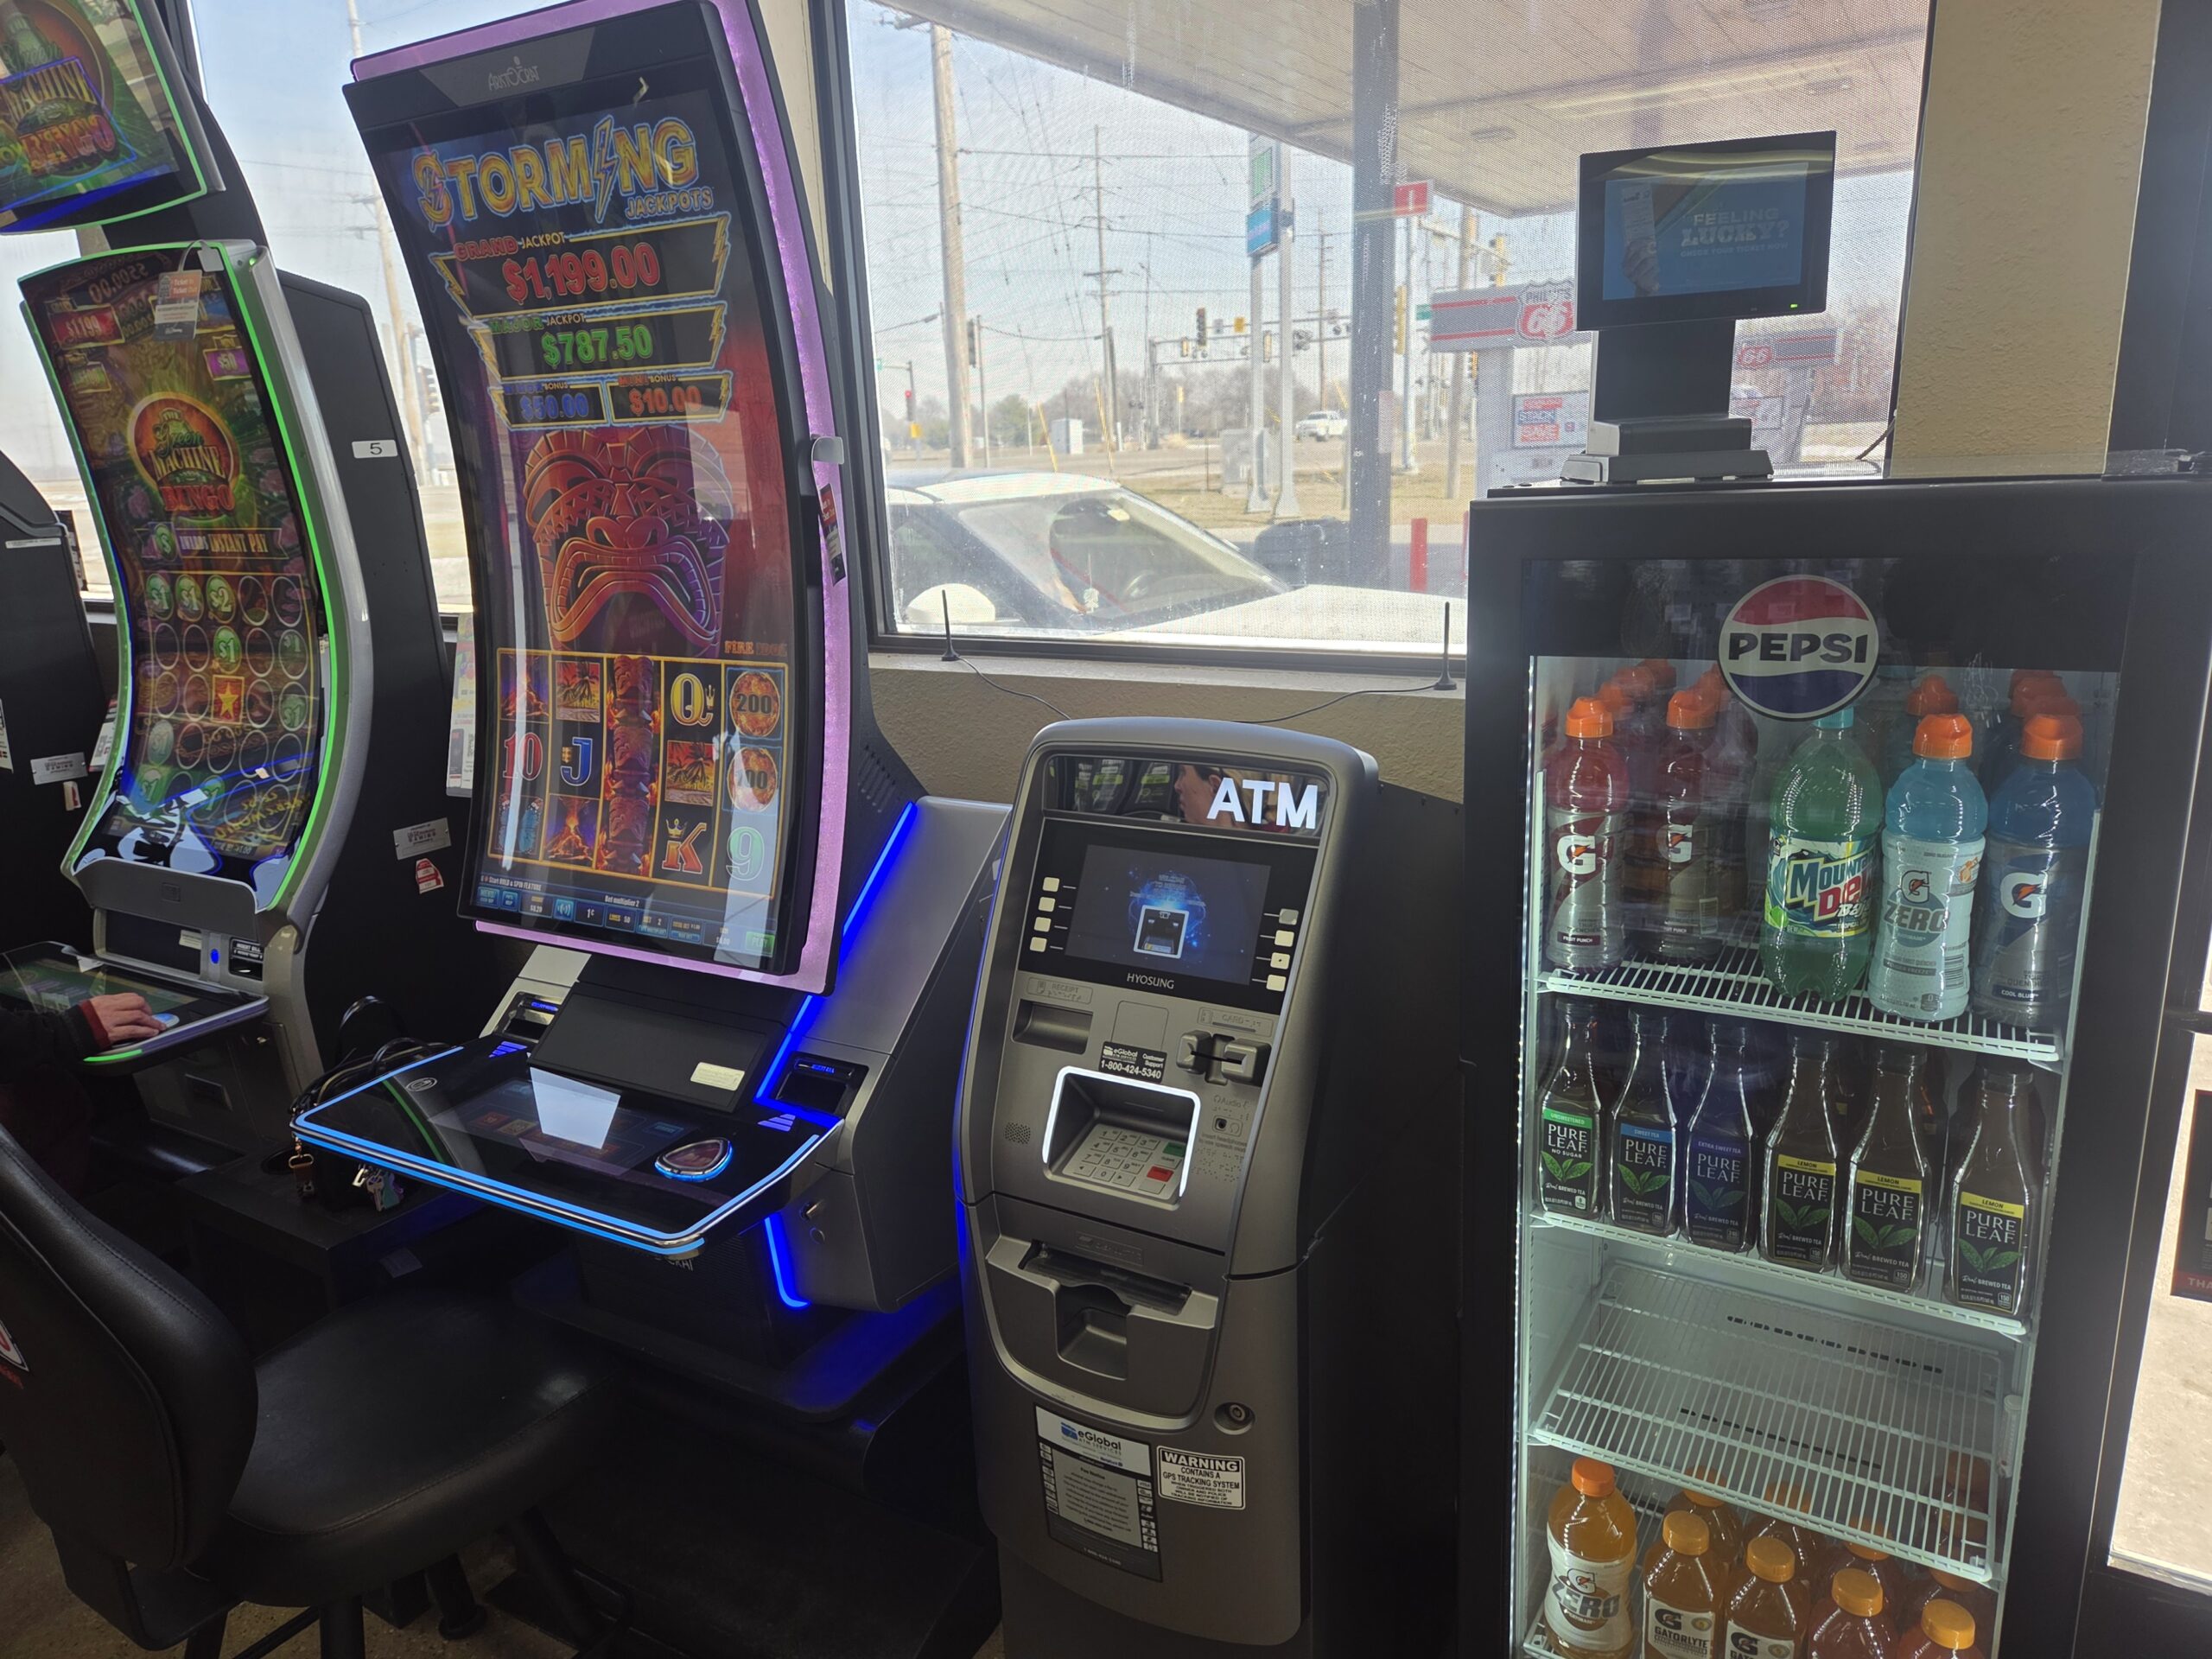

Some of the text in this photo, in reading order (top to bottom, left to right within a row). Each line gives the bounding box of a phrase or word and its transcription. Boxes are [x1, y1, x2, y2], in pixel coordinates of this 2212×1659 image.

[488, 65, 541, 91] ARISTOCRAT
[625, 187, 715, 219] JACKPOTS
[1693, 207, 1779, 226] FEELING
[1681, 220, 1789, 247] LUCKY?
[454, 232, 565, 261] GRAND JACKPOT
[502, 242, 661, 305] $1,199.00
[1525, 287, 1572, 302] PHILPS
[546, 313, 586, 327] JACKPOT
[541, 325, 653, 369] $787.50
[544, 381, 569, 391] BONUS
[649, 373, 677, 384] BONUS
[520, 393, 589, 423] $50.00
[629, 385, 702, 416] $10.00
[369, 442, 383, 455] 5
[149, 445, 226, 481] MACHINE
[160, 485, 236, 512] BINGO
[248, 534, 269, 553] PAY
[724, 640, 754, 654] FIRE
[1729, 632, 1869, 664] PEPSI
[736, 694, 772, 715] 200
[560, 736, 594, 786] J
[1206, 777, 1319, 830] ATM
[662, 822, 708, 874] K
[1656, 823, 1694, 862] G
[725, 826, 765, 881] 9
[1557, 834, 1596, 874] G
[1999, 872, 2047, 918] G
[1884, 901, 1950, 933] ZERO
[1127, 973, 1174, 989] HYOSUNG
[1101, 1059, 1162, 1079] 1-800-424-5340
[1145, 1060, 1164, 1069] Support
[1548, 1123, 1587, 1142] PURE
[1625, 1139, 1668, 1157] PURE
[1698, 1153, 1741, 1173] PURE
[1558, 1185, 1577, 1194] BREWED
[1783, 1171, 1830, 1192] PURE
[1877, 1175, 1900, 1185] LEMON
[1636, 1199, 1654, 1209] BREWED
[1862, 1187, 1915, 1209] PURE
[1981, 1198, 2004, 1209] LEMON
[1708, 1216, 1729, 1225] BREWED
[1967, 1210, 2017, 1233] PURE
[1792, 1235, 1813, 1244] BREWED
[1872, 1255, 1897, 1267] BREWED
[1898, 1259, 1910, 1268] TEA
[1978, 1278, 2000, 1289] BREWED
[2001, 1282, 2012, 1291] TEA
[1999, 1294, 2010, 1302] 150
[1077, 1428, 1122, 1451] eGlobal
[1164, 1452, 1238, 1471] WARNING
[1162, 1471, 1240, 1490] GPS TRACKING SYSTEM
[1180, 1466, 1214, 1478] CONTAINS
[1553, 1582, 1621, 1619] ZERO
[1654, 1625, 1708, 1649] GATORLYTE
